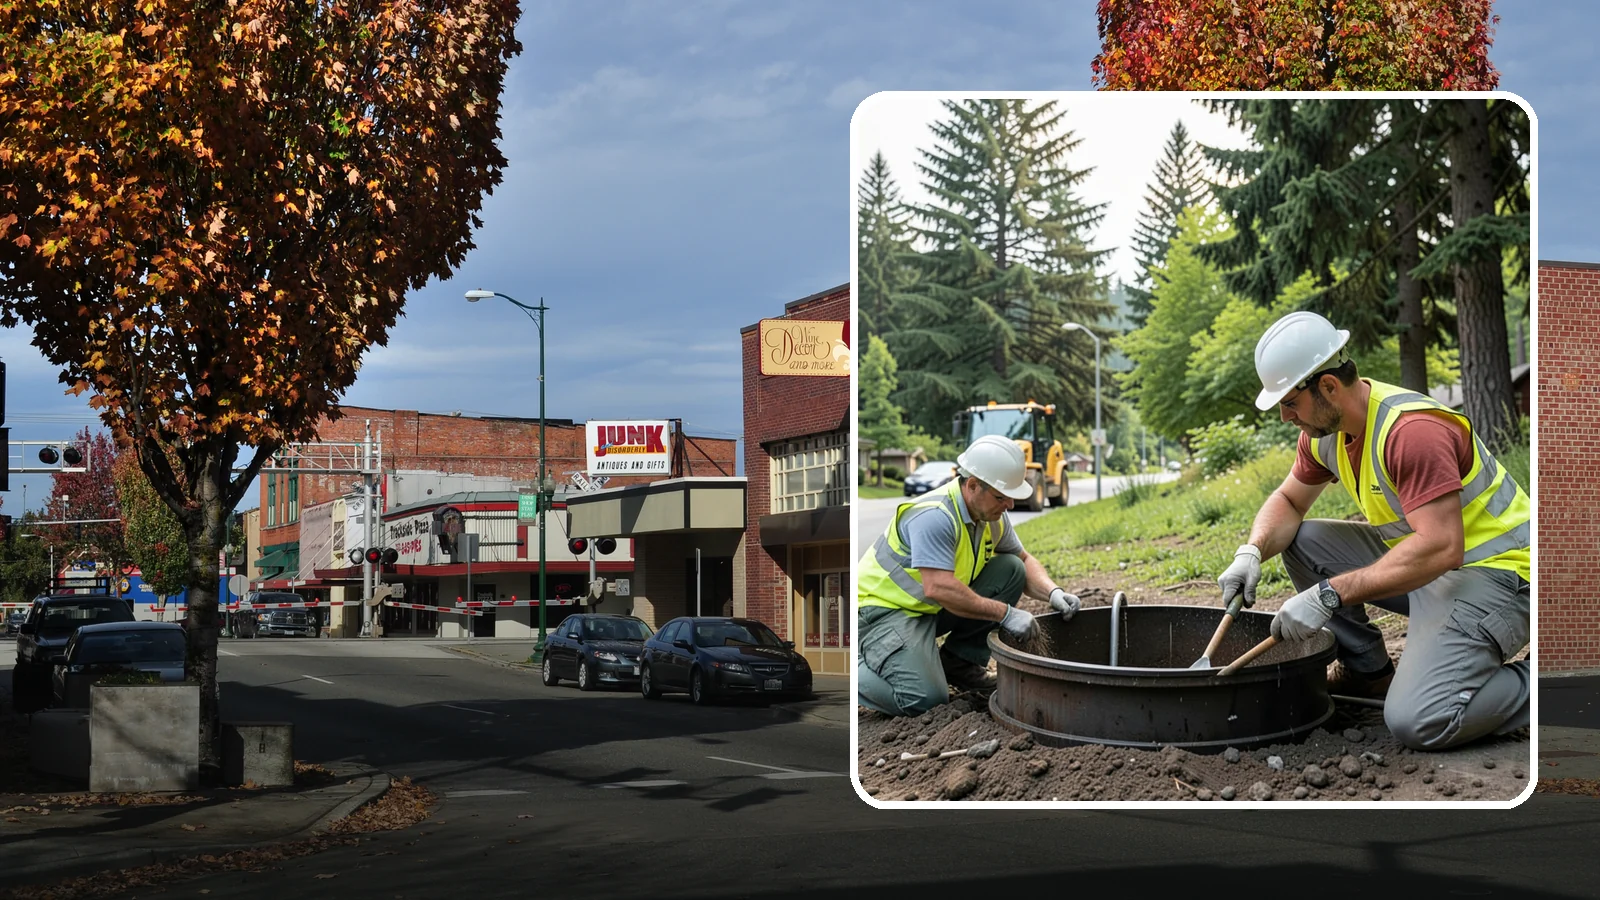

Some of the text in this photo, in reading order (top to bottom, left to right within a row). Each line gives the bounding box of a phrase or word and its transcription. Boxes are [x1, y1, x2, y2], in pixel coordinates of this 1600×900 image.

[791, 325, 824, 345] Wine
[765, 327, 831, 365] Decor
[595, 425, 665, 457] JUNK
[607, 446, 646, 454] DISORDERLY
[597, 461, 665, 470] ANTIQUES AND GIFTS
[414, 519, 429, 535] Pizza
